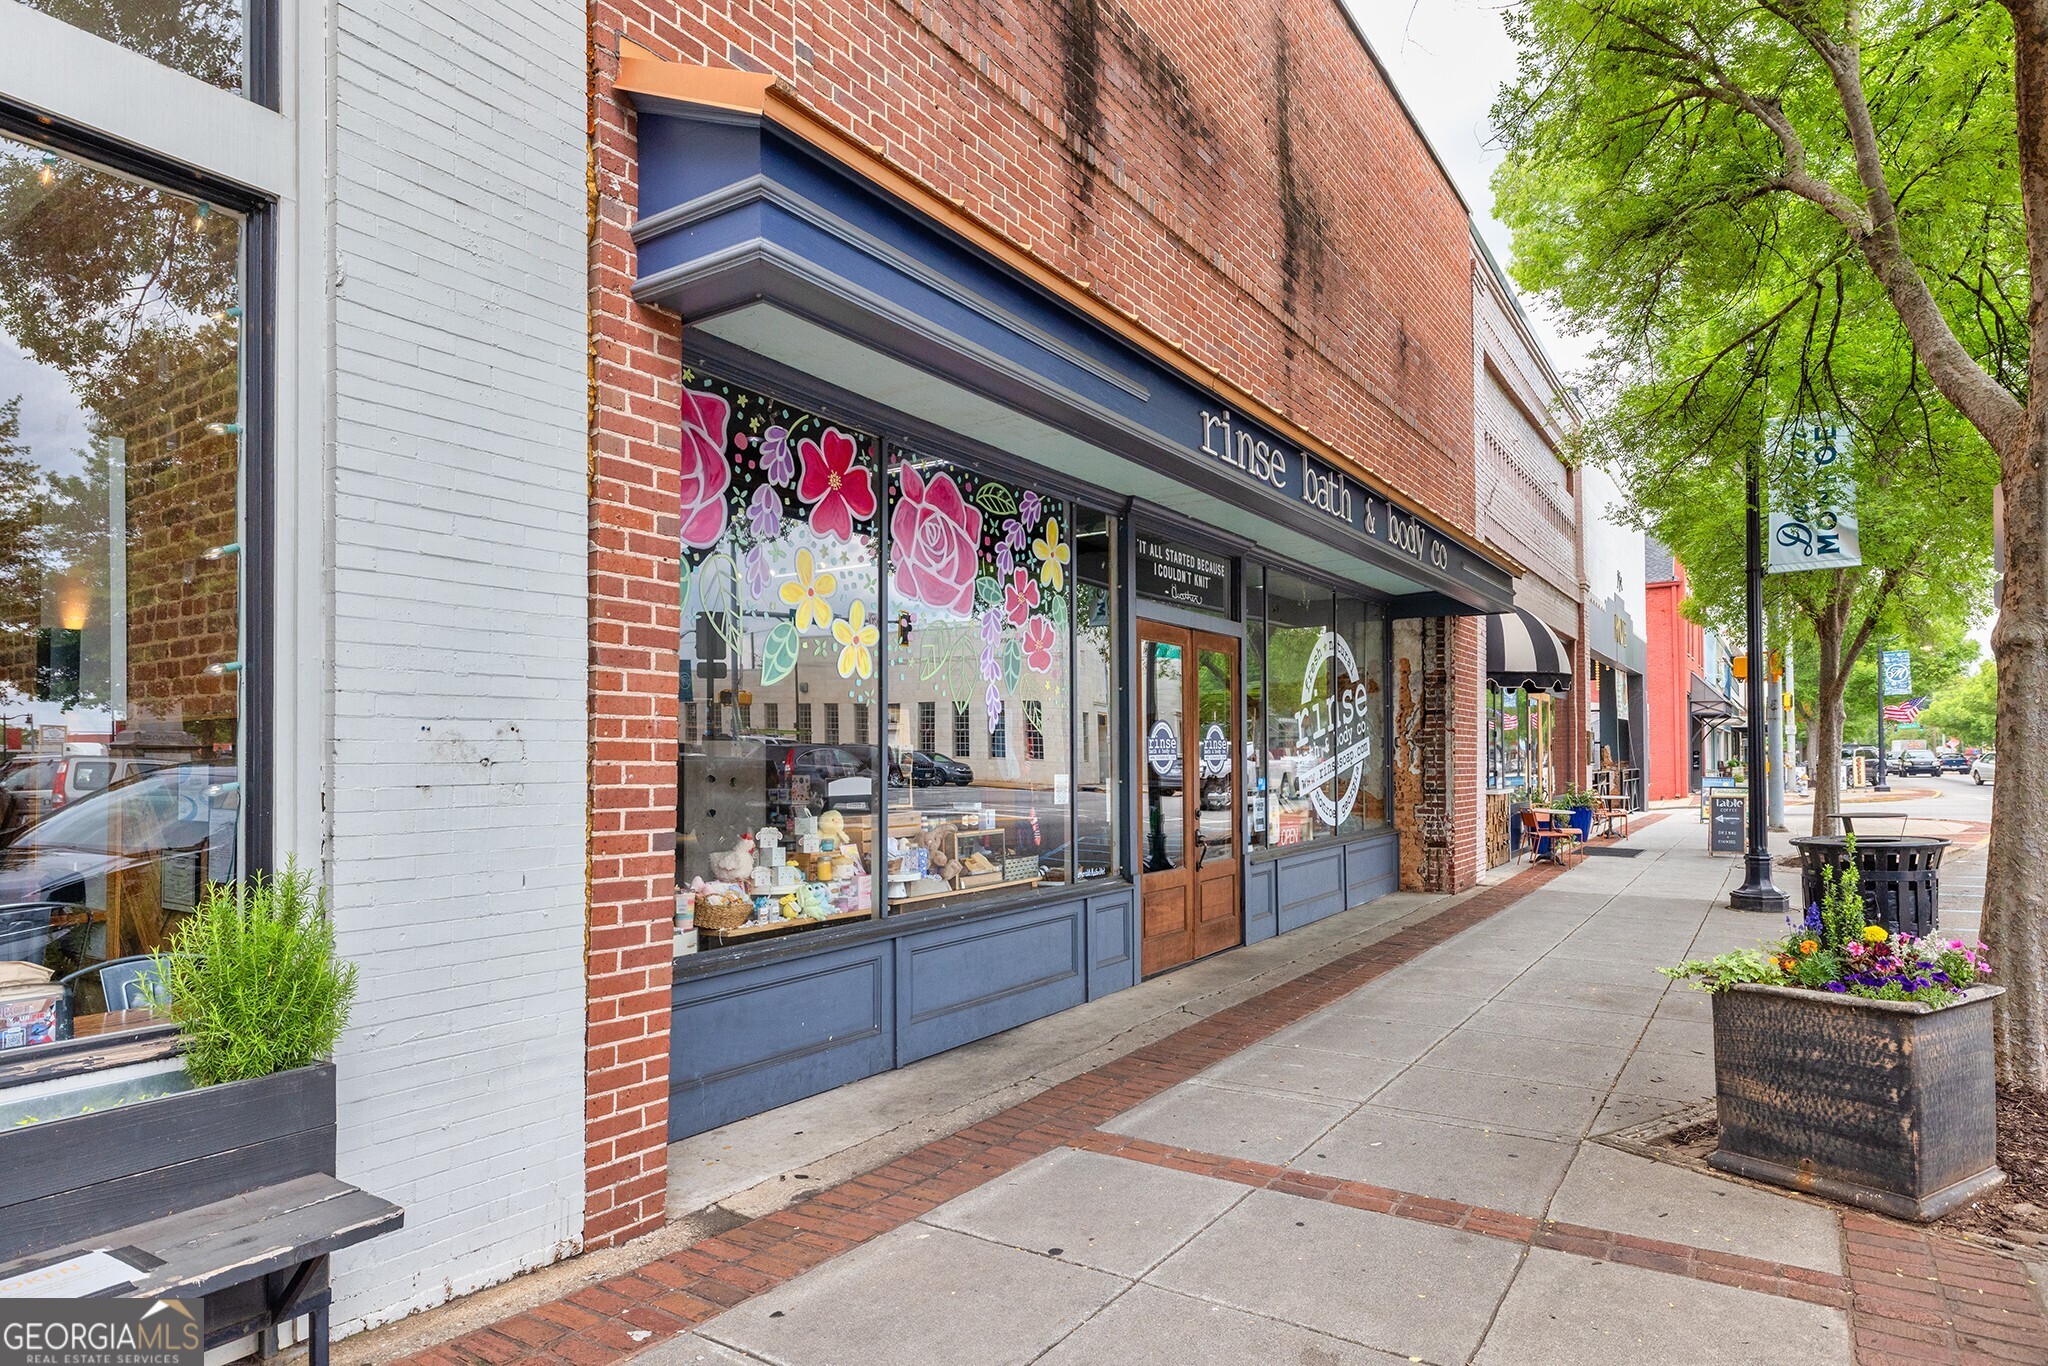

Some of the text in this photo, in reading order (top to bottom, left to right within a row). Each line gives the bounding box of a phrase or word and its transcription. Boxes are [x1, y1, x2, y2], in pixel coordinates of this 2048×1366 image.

[1200, 410, 1448, 570] rinse bath & body co
[1149, 543, 1163, 559] ALL
[1165, 548, 1195, 568] STARTED
[1197, 557, 1225, 577] BECAUSE
[1153, 562, 1157, 576] I
[1158, 563, 1192, 585] COULDN'T
[1294, 682, 1368, 749] rinse
[1148, 735, 1177, 749] rinse
[1204, 736, 1227, 749] rinse
[1281, 826, 1300, 846] OPEN
